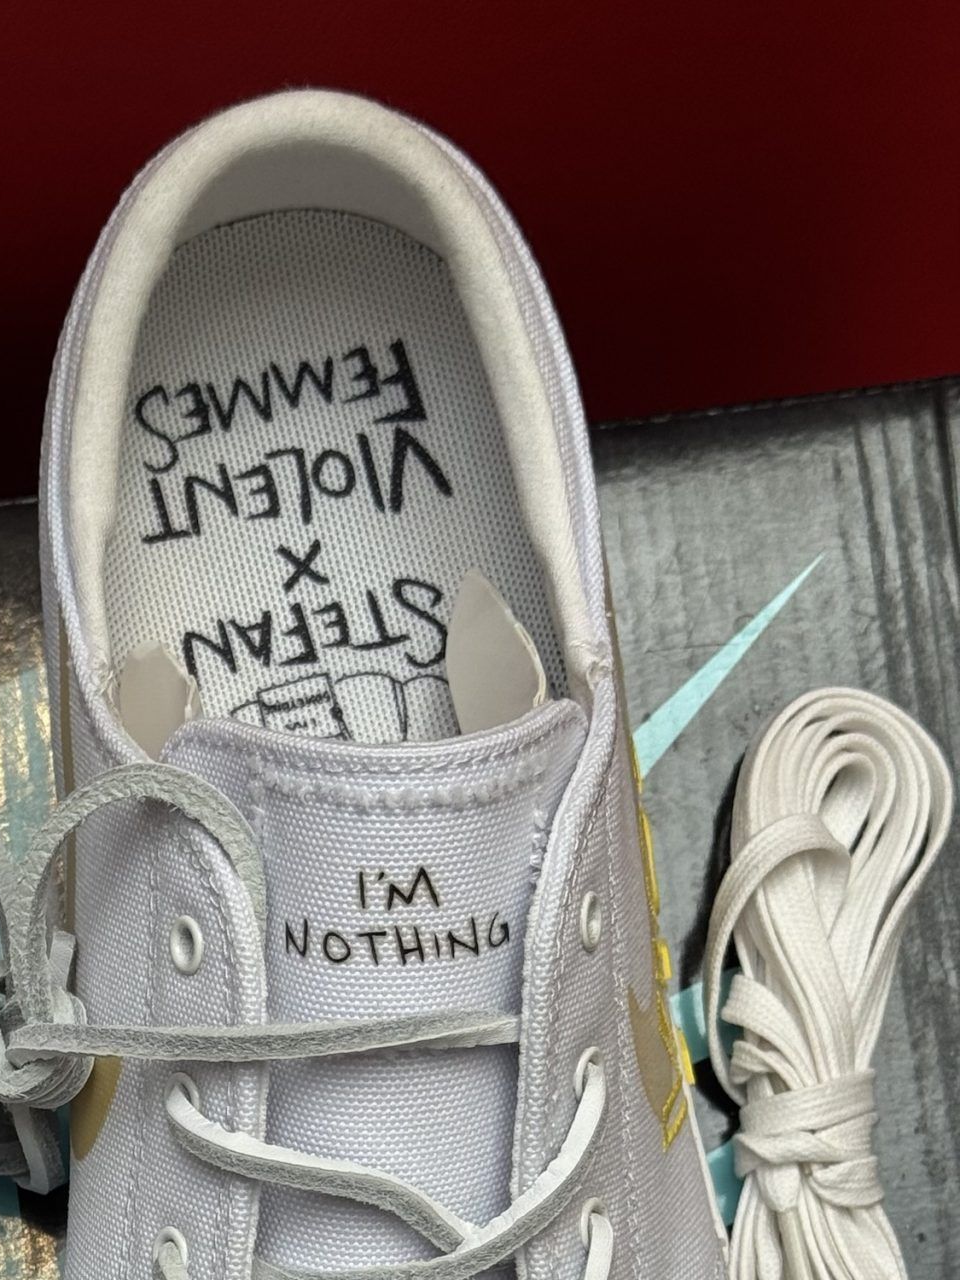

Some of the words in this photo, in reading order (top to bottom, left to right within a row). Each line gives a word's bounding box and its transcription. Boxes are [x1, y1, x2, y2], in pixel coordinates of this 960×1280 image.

[136, 338, 428, 474] FEMMES
[141, 426, 454, 544] VIOLENT
[181, 577, 450, 678] STEFAN
[284, 911, 510, 966] NOTHING
[358, 866, 440, 911] I'M
